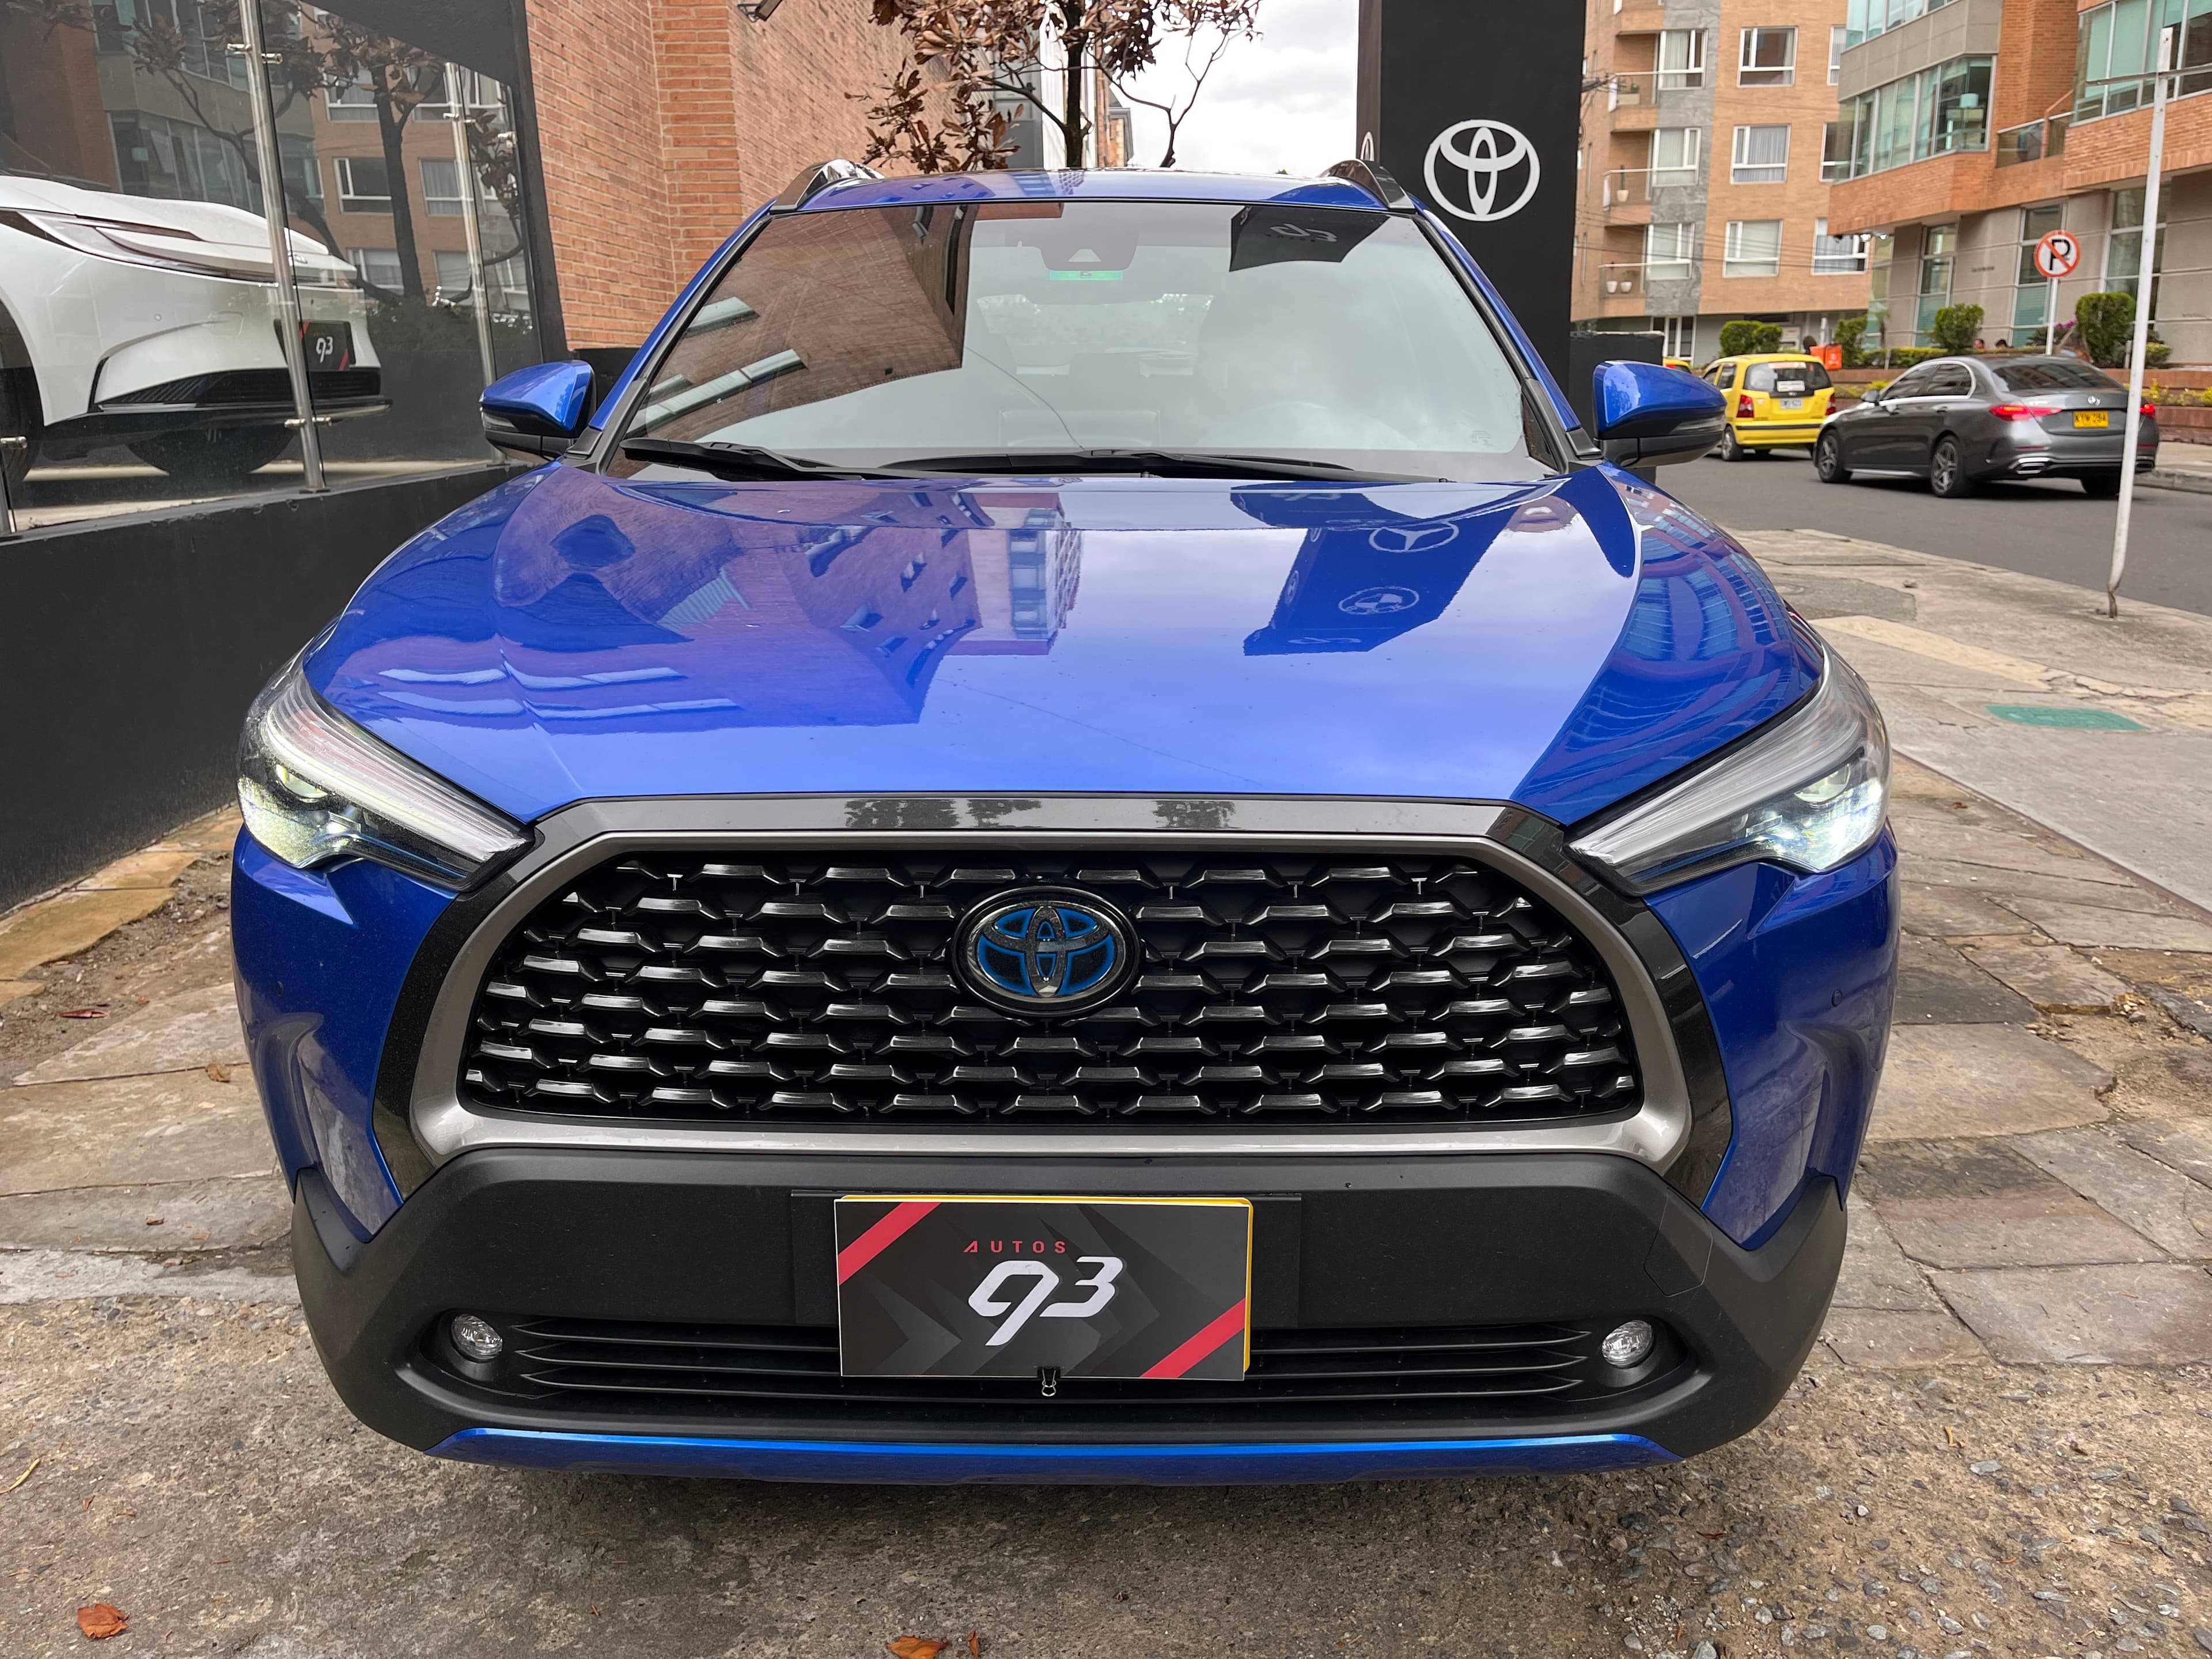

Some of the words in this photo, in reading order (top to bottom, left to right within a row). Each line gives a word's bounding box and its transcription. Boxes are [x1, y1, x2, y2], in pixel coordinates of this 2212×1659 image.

[2049, 239, 2070, 271] P
[316, 336, 334, 363] 93
[963, 1240, 1066, 1253] AUTOS
[968, 1256, 1123, 1347] 93
